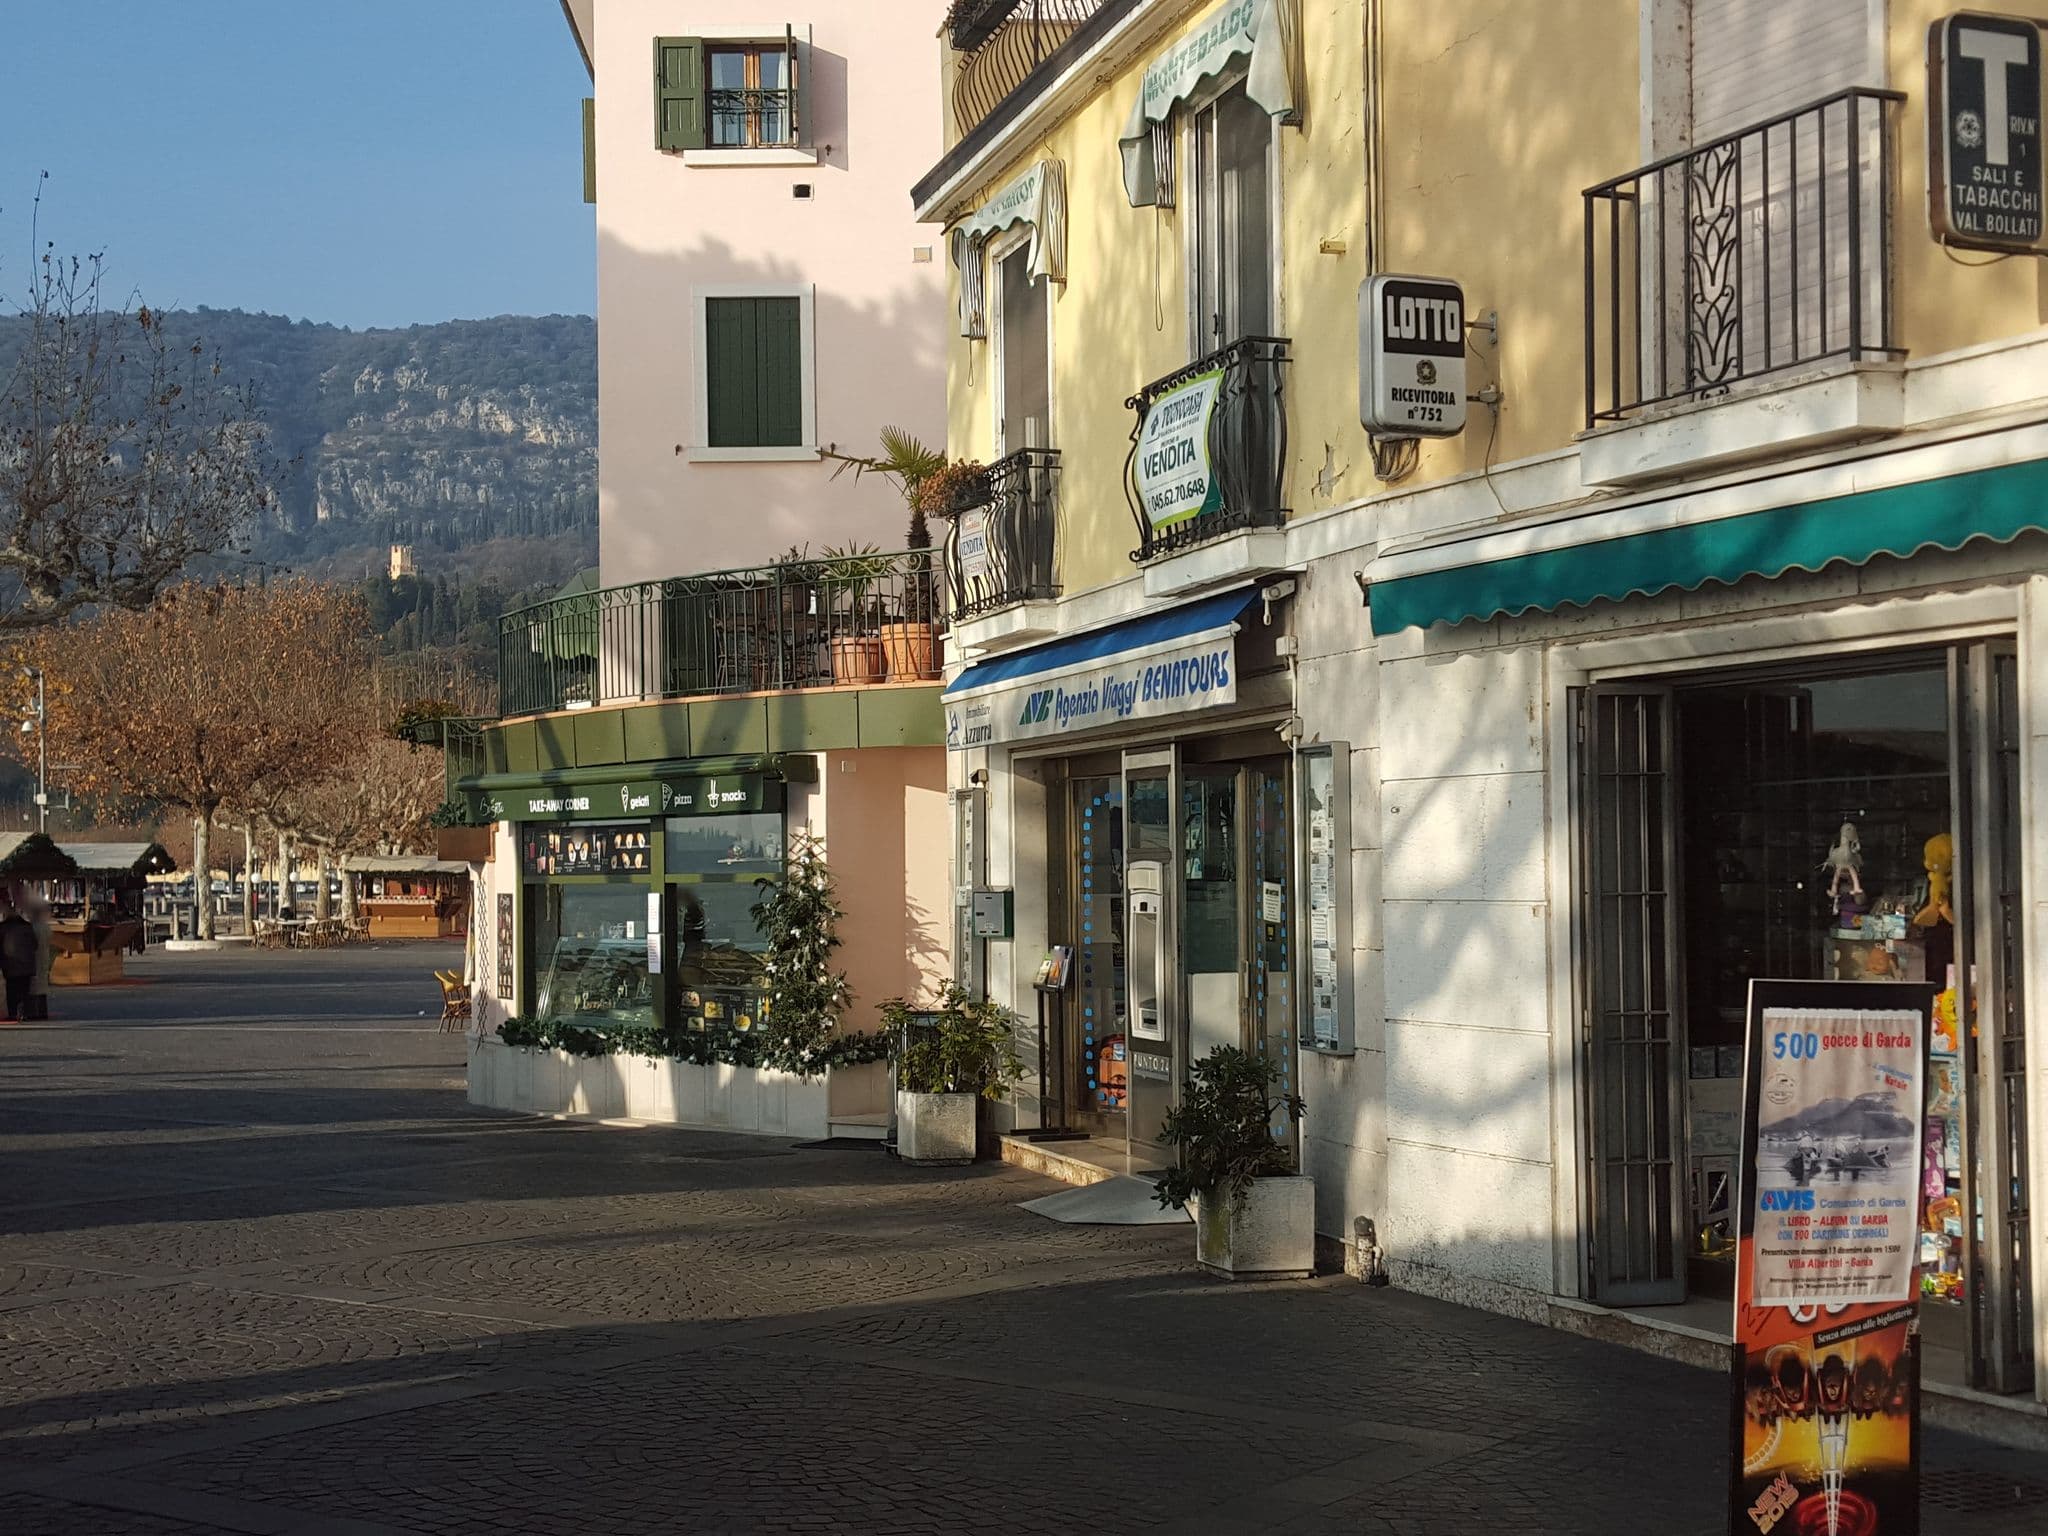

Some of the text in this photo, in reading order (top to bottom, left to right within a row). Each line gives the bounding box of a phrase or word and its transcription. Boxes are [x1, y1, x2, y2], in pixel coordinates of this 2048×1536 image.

[1959, 28, 2029, 165] T
[1972, 166, 2024, 186] SALI E
[1956, 184, 2038, 212] TABACCHI
[1956, 211, 2038, 237] VAL BOLLATI
[1386, 295, 1461, 343] LOTTO
[1391, 387, 1456, 406] RICEVITORIA
[1421, 408, 1442, 422] 752
[1144, 437, 1196, 480] VENDITA
[1151, 478, 1206, 512] 045.62.70.648
[1055, 681, 1098, 727] Agenzia
[1103, 670, 1140, 716] Viaggi
[1142, 650, 1230, 699] BENATOURS
[963, 723, 992, 745] Azzurra
[529, 797, 590, 813] TAKE-AWAY CORNER
[630, 795, 650, 810] gelati
[674, 794, 692, 807] pizza
[721, 790, 746, 802] snacks
[1773, 1032, 1911, 1059] 500 gocce di Garda
[1760, 1190, 1815, 1211] AVIS
[1820, 1197, 1906, 1209] Comunale di Garda
[1787, 1215, 1811, 1227] LIBRO
[1820, 1215, 1848, 1226] ALBUM
[1861, 1214, 1888, 1225] GARDA
[1794, 1229, 1809, 1241] 500
[1788, 1258, 1805, 1269] Villa
[1807, 1257, 1842, 1269] Albertini
[1851, 1256, 1873, 1267] Garda
[1817, 1308, 1913, 1344] Senza attesa alle biglietterie
[1747, 1470, 1789, 1527] NEW
